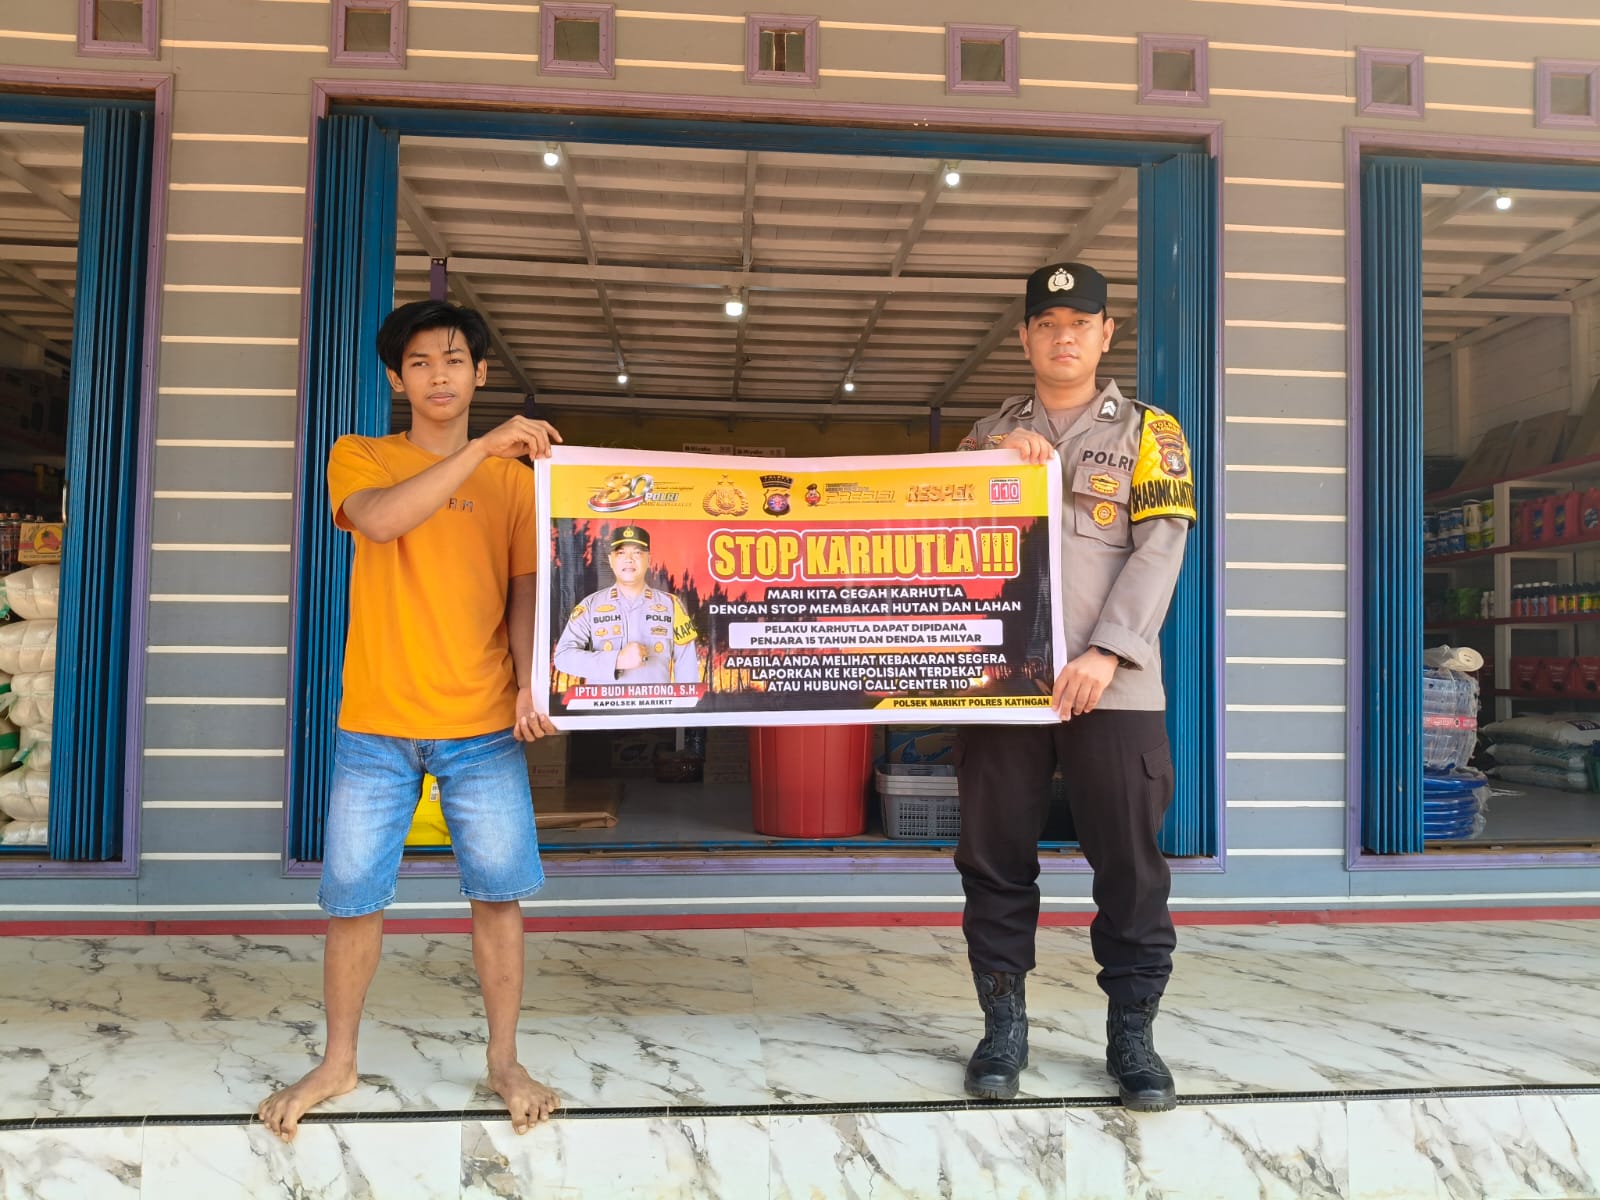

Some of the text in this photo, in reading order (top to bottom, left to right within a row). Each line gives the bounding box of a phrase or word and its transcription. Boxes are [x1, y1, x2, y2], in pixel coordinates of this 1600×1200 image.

[1082, 450, 1134, 472] POLRI
[645, 492, 679, 502] POLRI
[904, 484, 976, 502] RESPEK
[992, 484, 1018, 499] 110
[714, 532, 1014, 577] STOP KARHUTLA !!!
[767, 587, 964, 600] MARI KITA CEGAH KARHUTLA
[709, 601, 1021, 615] DENGAN STOP MEMBAKAR HUTAN DAN LAHAN
[645, 614, 672, 623] POLRI
[765, 623, 967, 634] PELAKU KARHUTLA DAPAT DIPIDANA
[750, 634, 982, 645] PENJARA 15 TAHUN DAN DENDA 15 MILYAR
[726, 654, 1007, 667] APABILA ANDA MELIHAT KEBAKARAN SEGERA
[752, 666, 982, 679] LAPORKAN KE KEPOLISIAN TERDEKAT
[575, 685, 699, 697] IPTU BUDI HARTONO, S.H.
[767, 679, 968, 691] ATAU HUBUNGI CALL CENTER 110
[893, 698, 1050, 707] POLSEK MARIKIT POLRES KATINGAN
